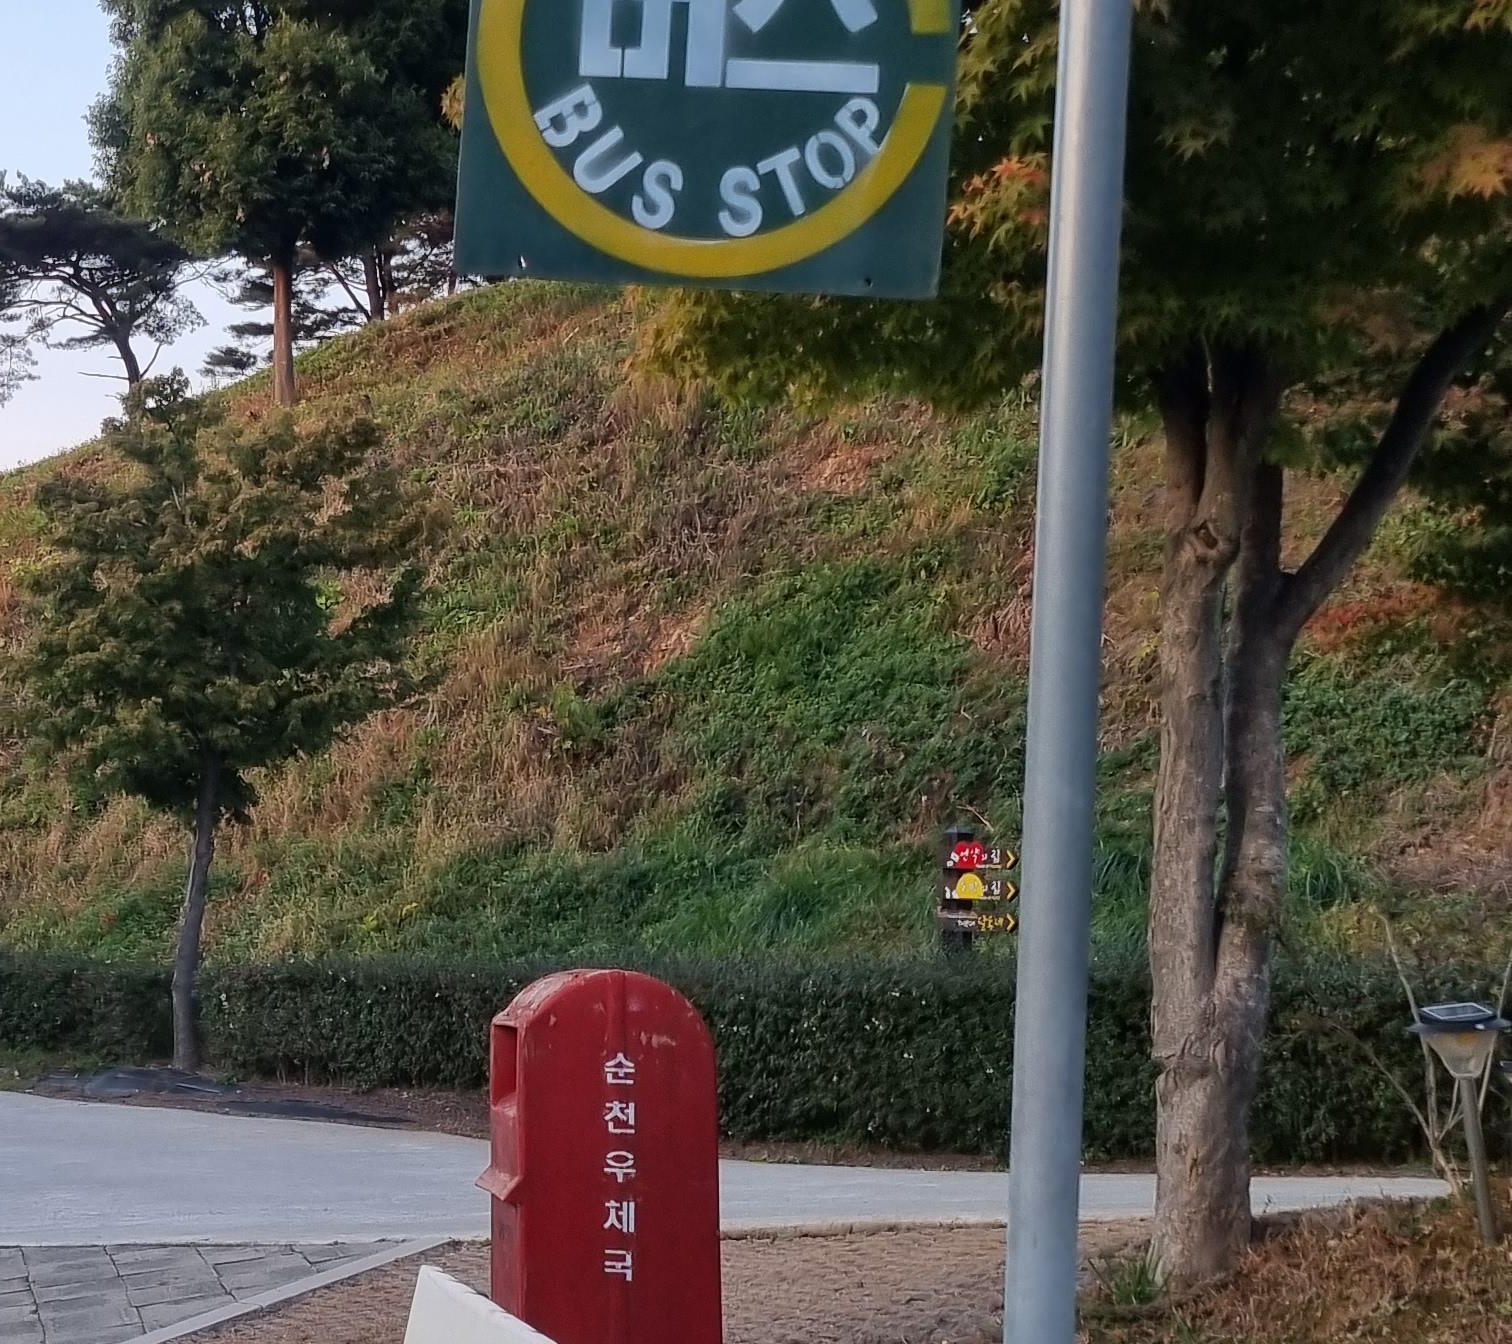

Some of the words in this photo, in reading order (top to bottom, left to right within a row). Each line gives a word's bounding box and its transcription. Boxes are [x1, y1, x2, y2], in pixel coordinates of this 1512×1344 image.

[534, 83, 683, 230] BUS
[718, 96, 883, 238] STOP
[603, 1052, 636, 1282] 순천우체국
